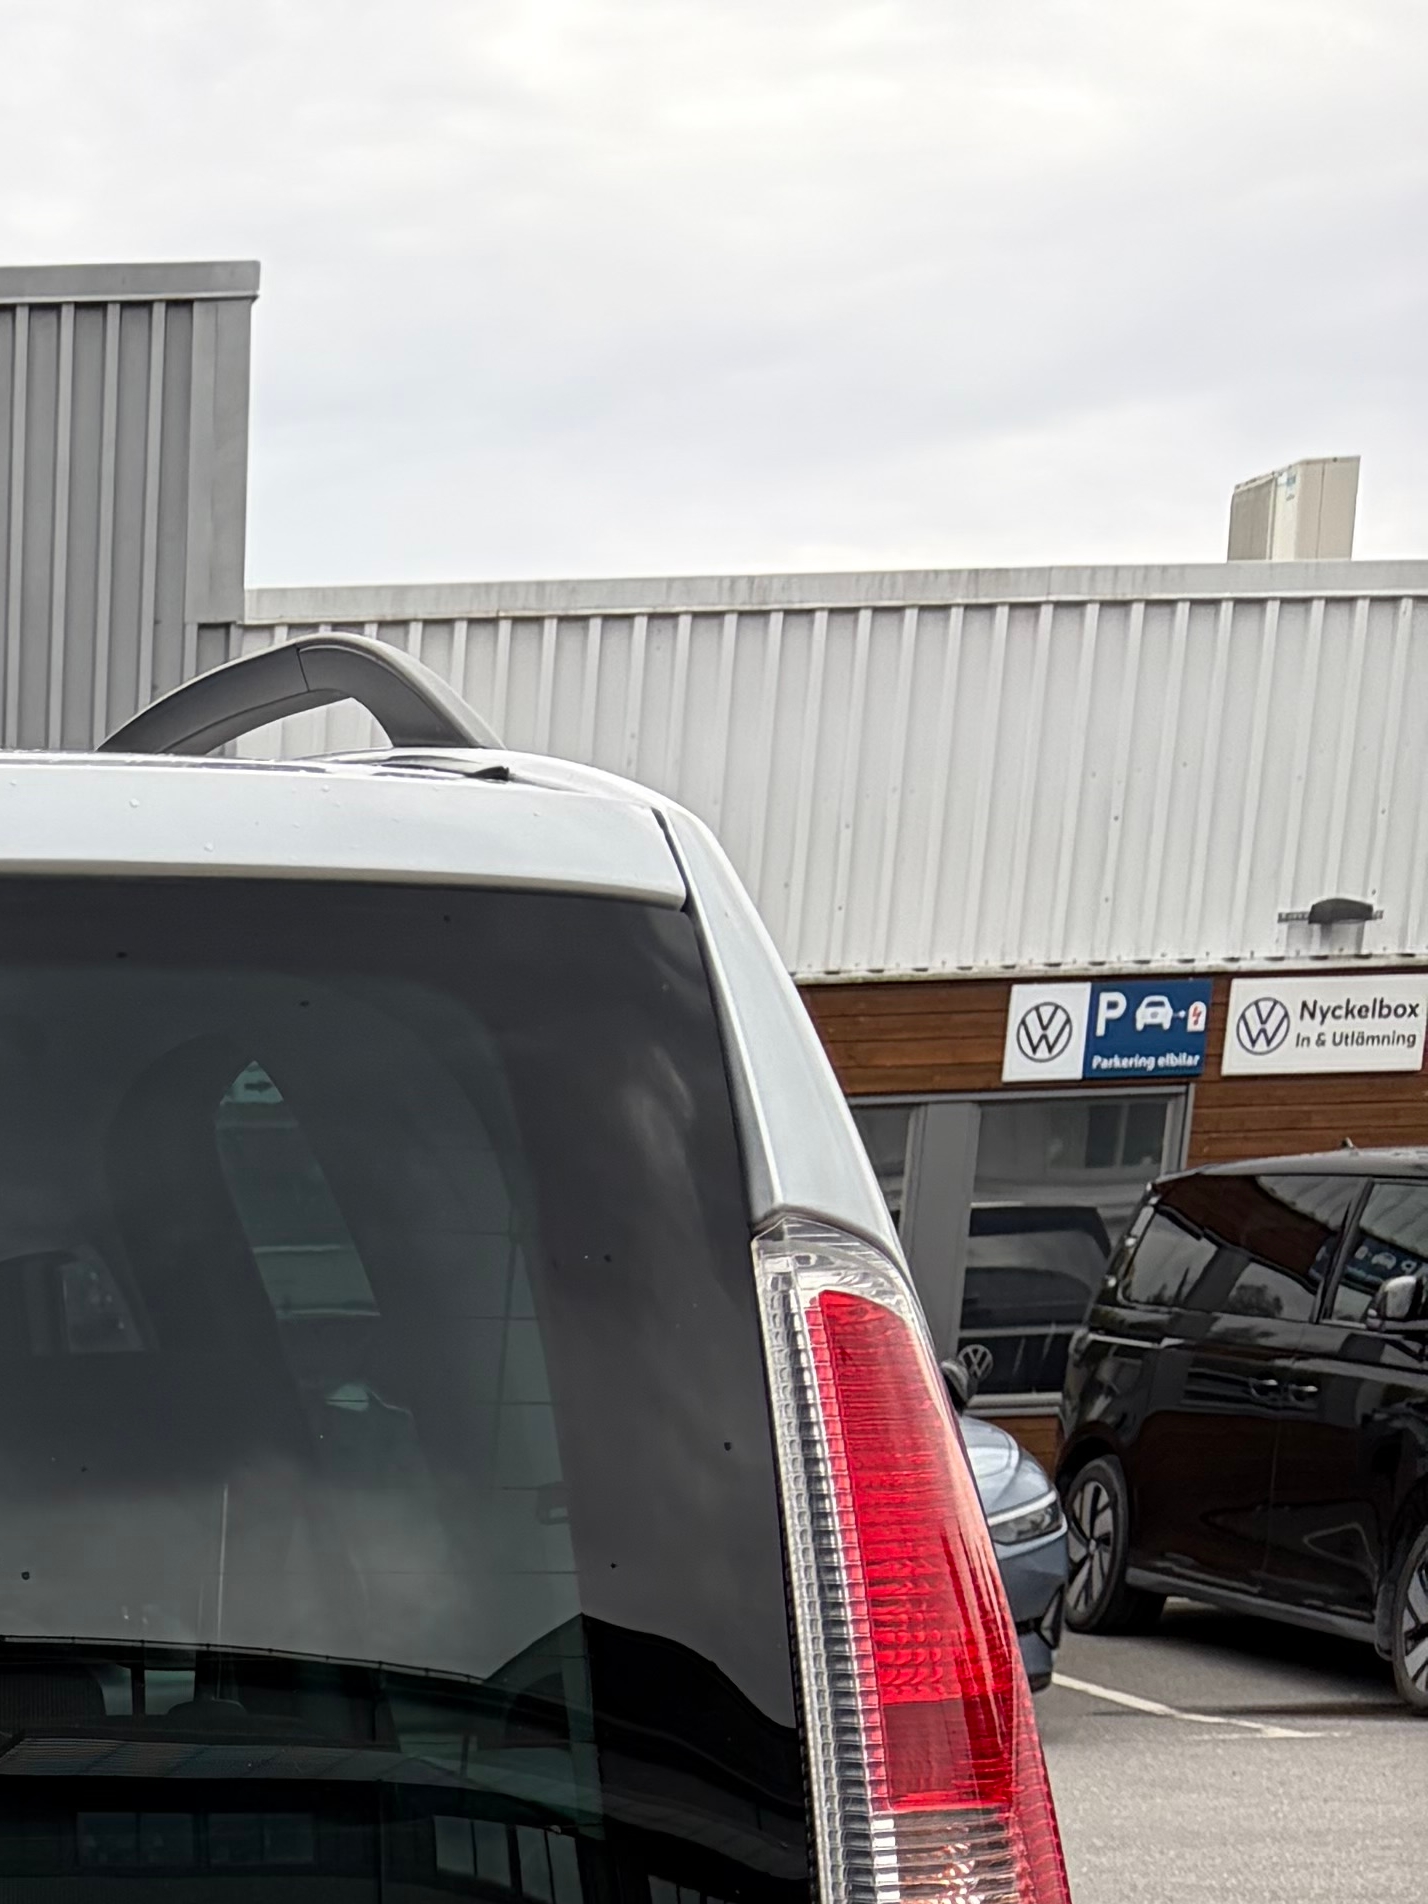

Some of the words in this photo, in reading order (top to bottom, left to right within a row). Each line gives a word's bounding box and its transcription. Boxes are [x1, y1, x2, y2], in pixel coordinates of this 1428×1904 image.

[1095, 991, 1127, 1037] P
[1299, 997, 1420, 1026] Nyckelbox
[1295, 1032, 1311, 1048] In
[1315, 1032, 1327, 1048] &
[1332, 1031, 1417, 1049] Utlämning
[1091, 1054, 1155, 1072] Parkering
[1157, 1052, 1200, 1068] elbilar
